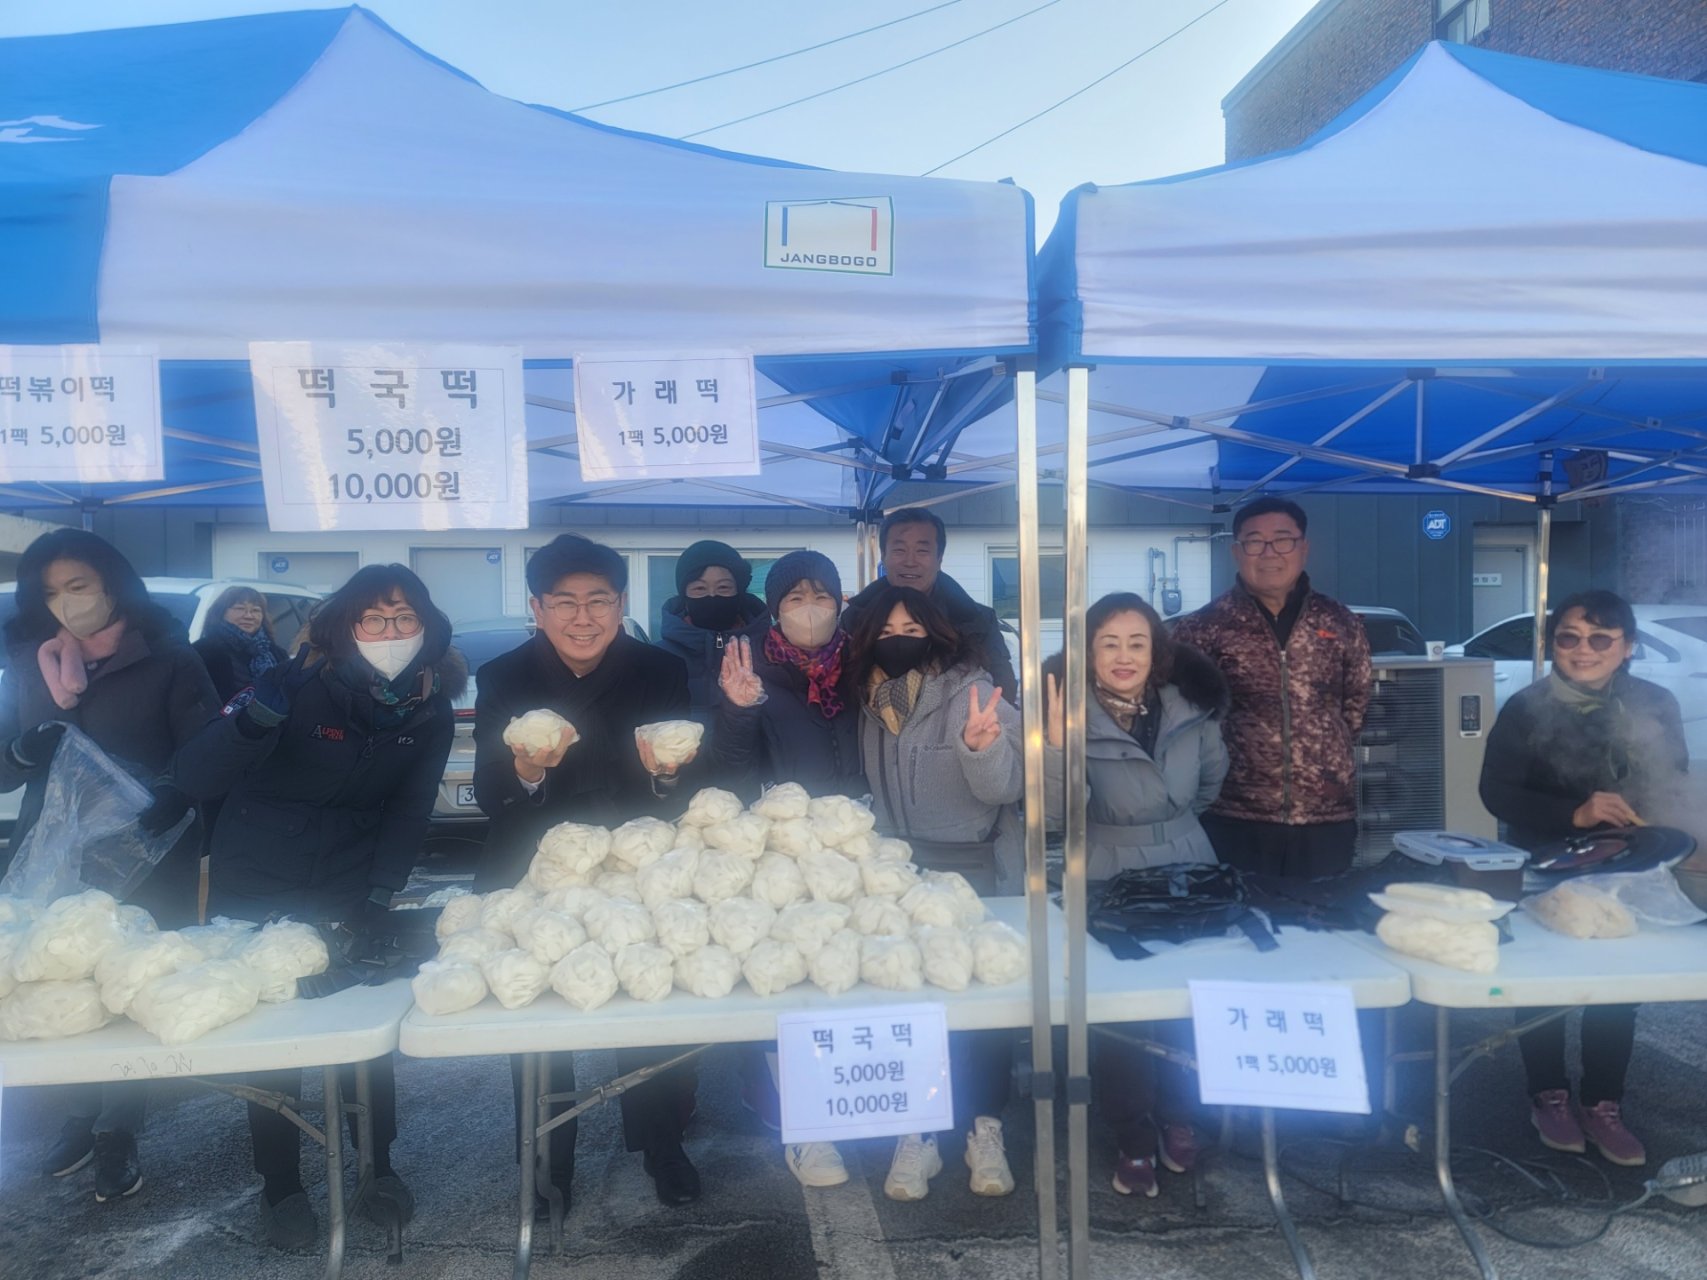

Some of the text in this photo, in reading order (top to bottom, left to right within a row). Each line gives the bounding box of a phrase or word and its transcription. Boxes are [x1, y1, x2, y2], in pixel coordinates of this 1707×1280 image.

[780, 253, 877, 268] JANGBOGO
[0, 375, 115, 402] 떡볶이떡
[0, 424, 127, 448] 1팩 5,000원
[346, 426, 463, 459] 5,000원
[619, 423, 729, 448] 1팩 5,000원
[328, 470, 462, 503] 10,000원
[1426, 518, 1447, 530] ADT
[833, 1060, 905, 1086] 5,000원
[1235, 1054, 1338, 1079] 1팩 5,000원
[825, 1091, 909, 1117] 10,000원
